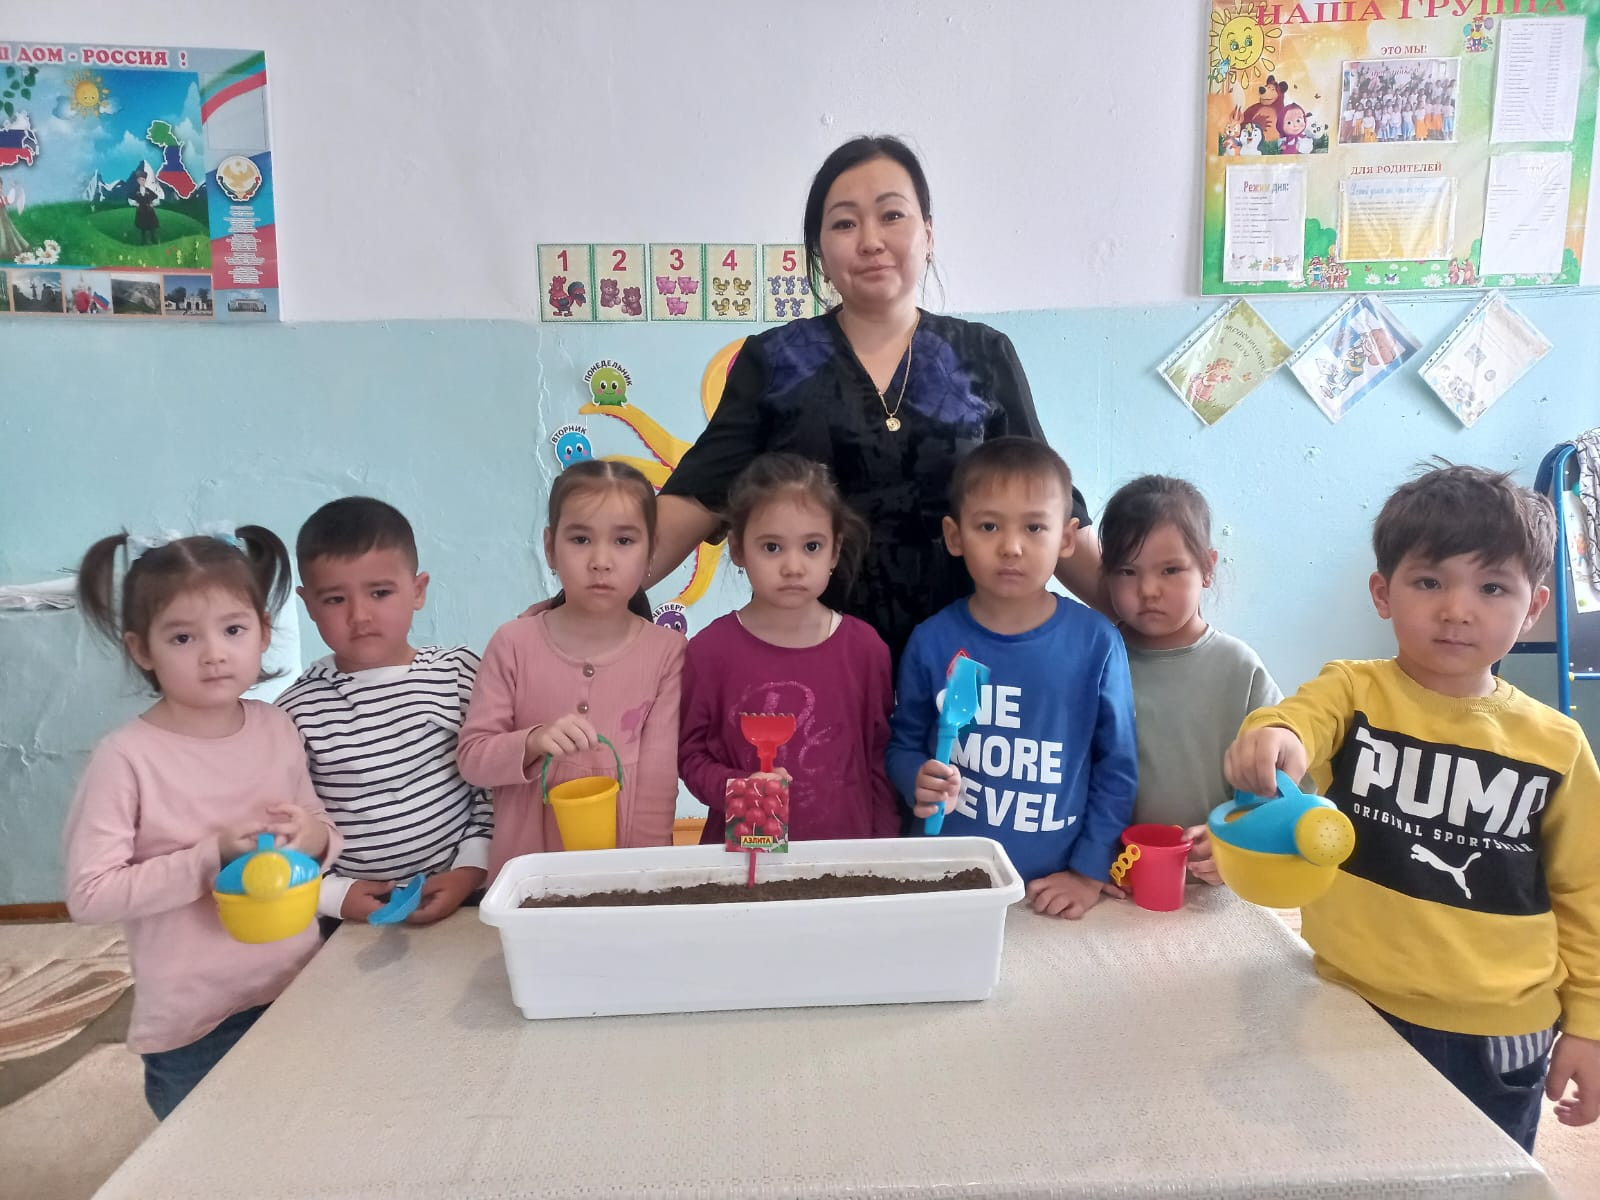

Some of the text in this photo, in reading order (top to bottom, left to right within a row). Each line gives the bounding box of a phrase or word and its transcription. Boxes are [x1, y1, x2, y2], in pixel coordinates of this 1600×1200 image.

[1255, 0, 1386, 26] НАША
[17, 47, 64, 63] ДОМ
[82, 49, 168, 66] РОССИЯ
[1381, 45, 1428, 55] ЭТО МЫ!
[1350, 161, 1443, 175] ДЛЯ РОДИТЕЛЕЙ
[557, 250, 568, 271] 1
[612, 250, 627, 271] 2
[669, 249, 685, 271] 3
[722, 249, 738, 271] 4
[782, 250, 797, 271] 5
[584, 360, 632, 386] ПОНЕДЕЛЬНИК
[551, 425, 587, 443] ВТОРНИК
[950, 733, 1063, 784] MORE
[956, 776, 1077, 833] EVEL.
[1353, 802, 1423, 837] ORIGINAL
